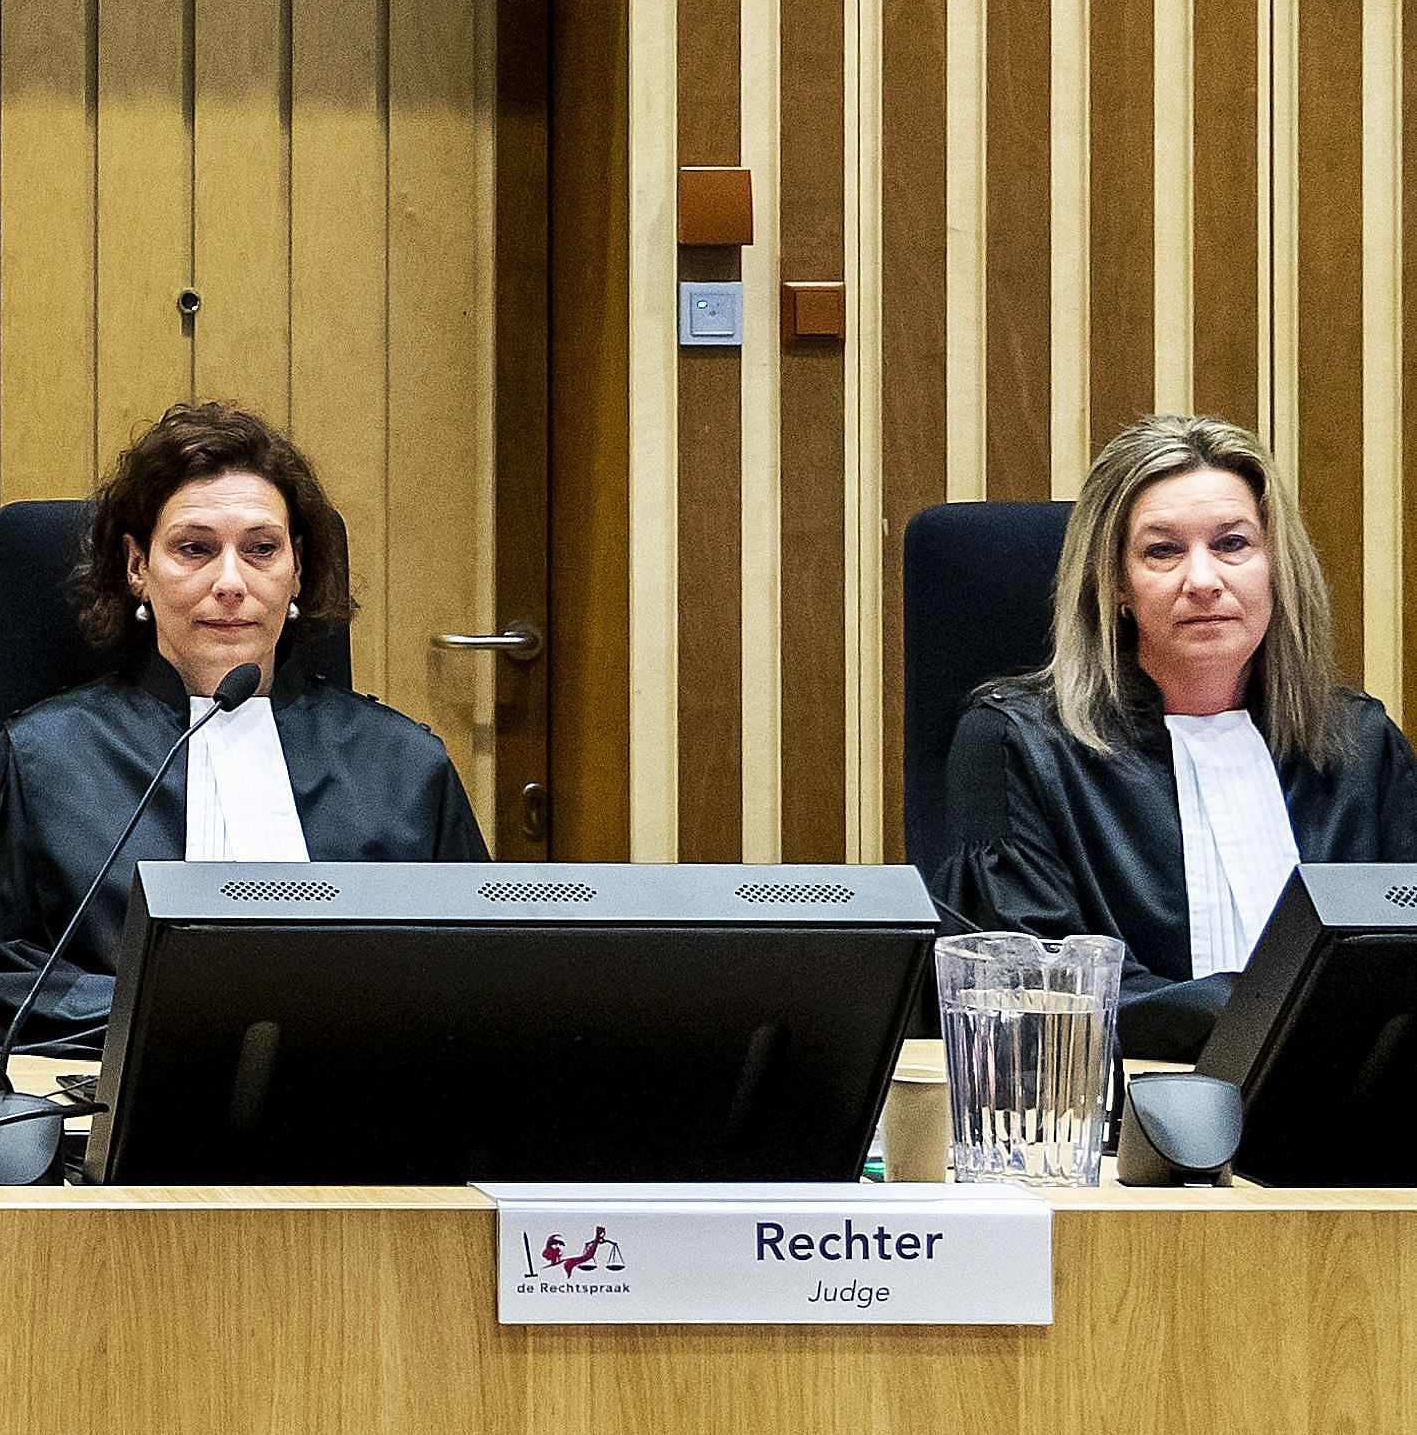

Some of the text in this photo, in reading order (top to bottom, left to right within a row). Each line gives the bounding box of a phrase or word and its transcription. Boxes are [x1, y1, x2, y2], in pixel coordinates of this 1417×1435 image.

[758, 1220, 944, 1261] Rechter
[517, 1283, 631, 1297] de Rechtspraak
[809, 1280, 890, 1309] Judge
